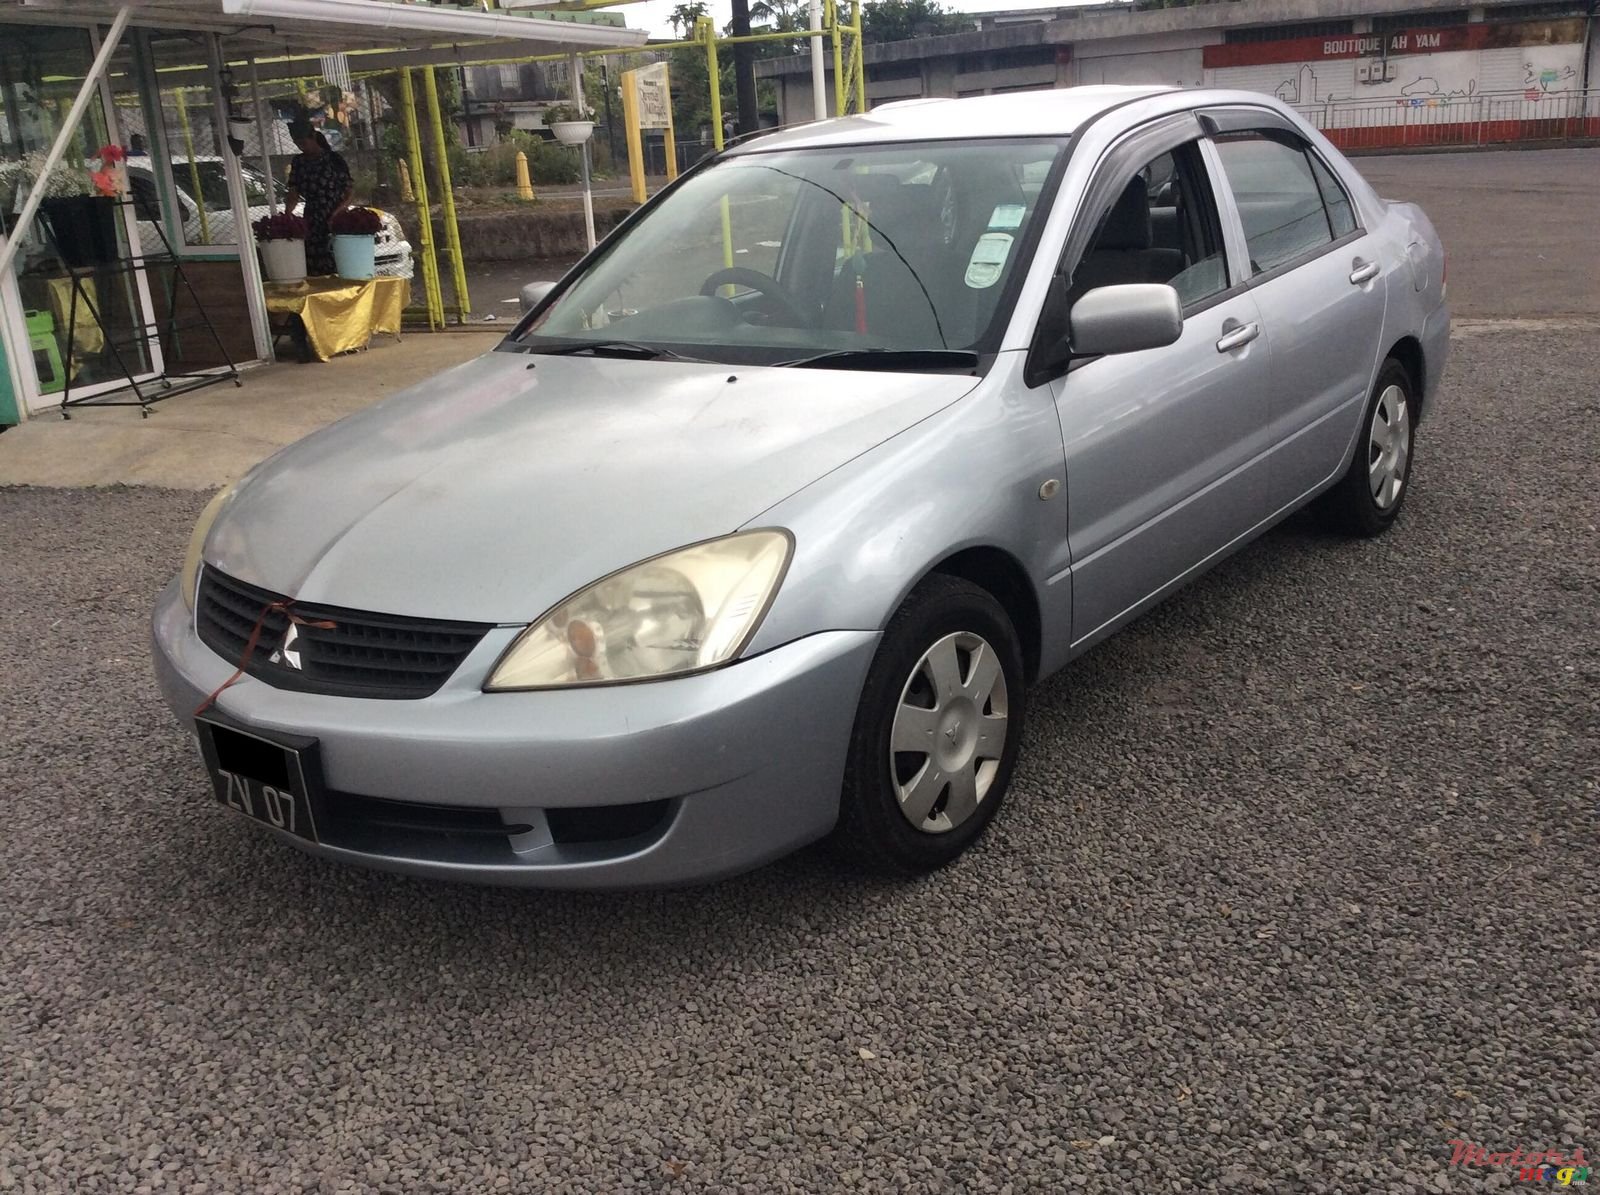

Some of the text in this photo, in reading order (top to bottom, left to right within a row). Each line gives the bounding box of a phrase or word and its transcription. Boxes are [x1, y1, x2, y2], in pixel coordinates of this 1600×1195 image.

[1323, 33, 1440, 54] BOUTIQUE AH YAM
[218, 768, 295, 832] ZV 07
